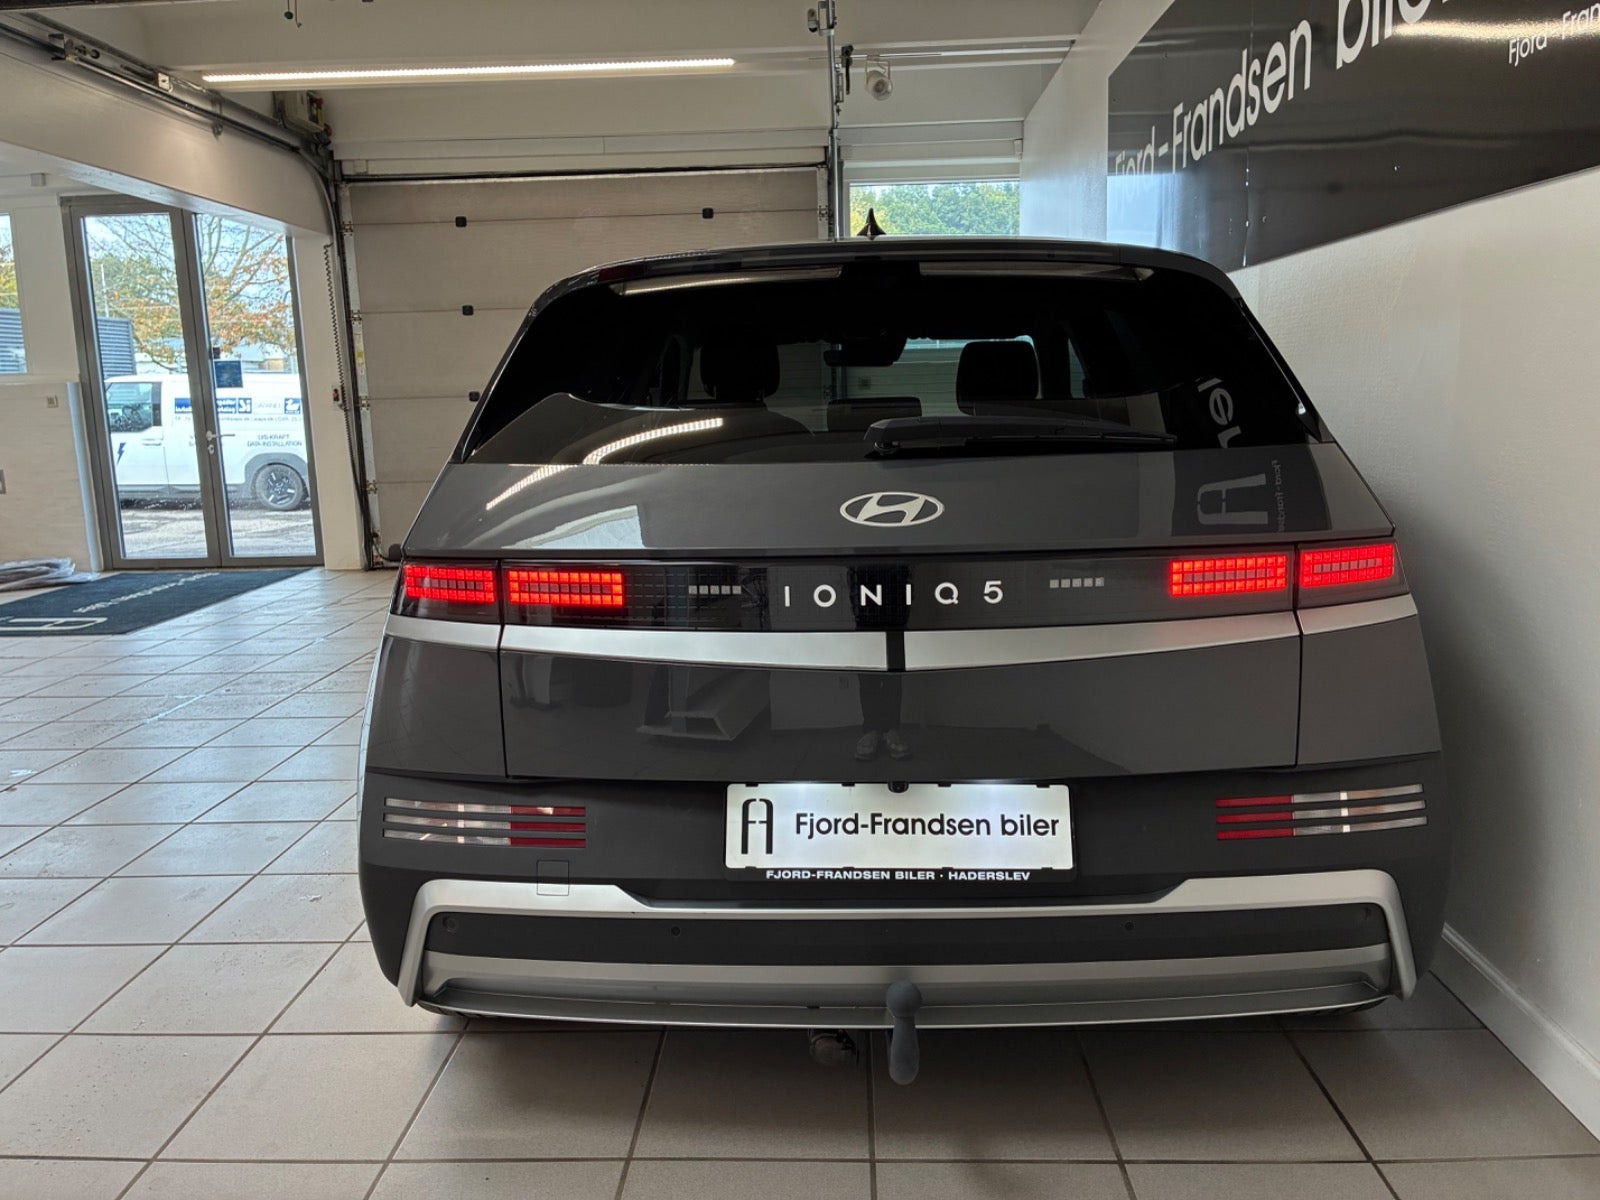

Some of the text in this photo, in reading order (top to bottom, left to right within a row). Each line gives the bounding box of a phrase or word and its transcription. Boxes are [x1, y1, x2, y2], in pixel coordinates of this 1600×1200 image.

[784, 580, 1004, 607] IONIQ 5
[795, 812, 1060, 839] Fjord-Frandsen biler
[766, 869, 1031, 881] FJORD-FRANDSEN BILER HADERSLEV
